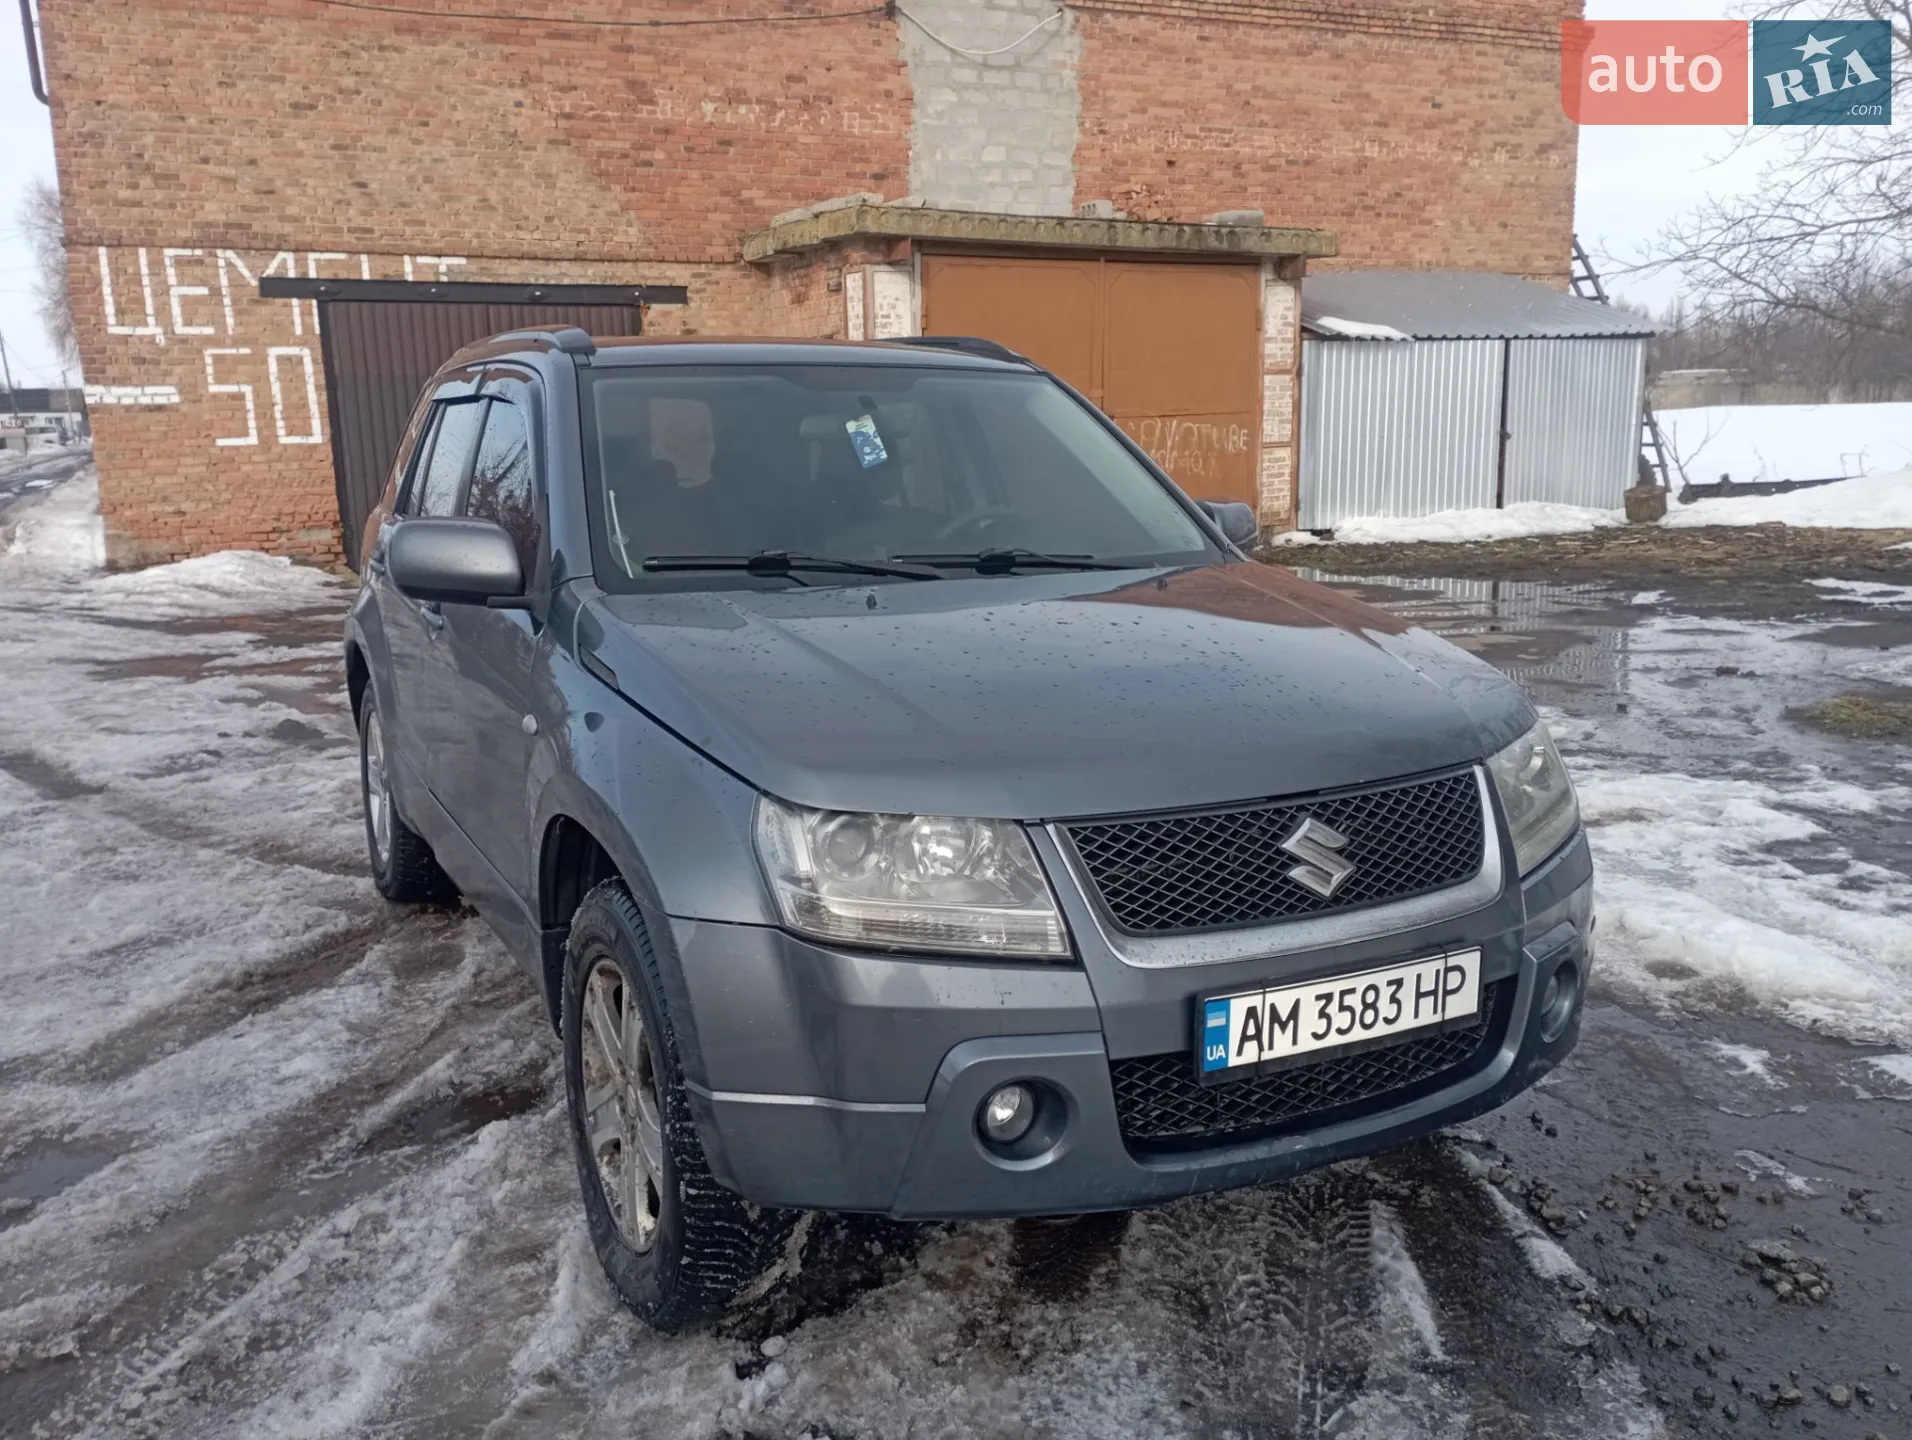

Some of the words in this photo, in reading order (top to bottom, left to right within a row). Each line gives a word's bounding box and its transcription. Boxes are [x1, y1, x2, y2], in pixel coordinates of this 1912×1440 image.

[203, 346, 323, 447] 50
[1206, 1044, 1227, 1061] UA
[1236, 998, 1300, 1057] AM
[1311, 977, 1404, 1041] 3583
[1413, 964, 1467, 1020] HP
